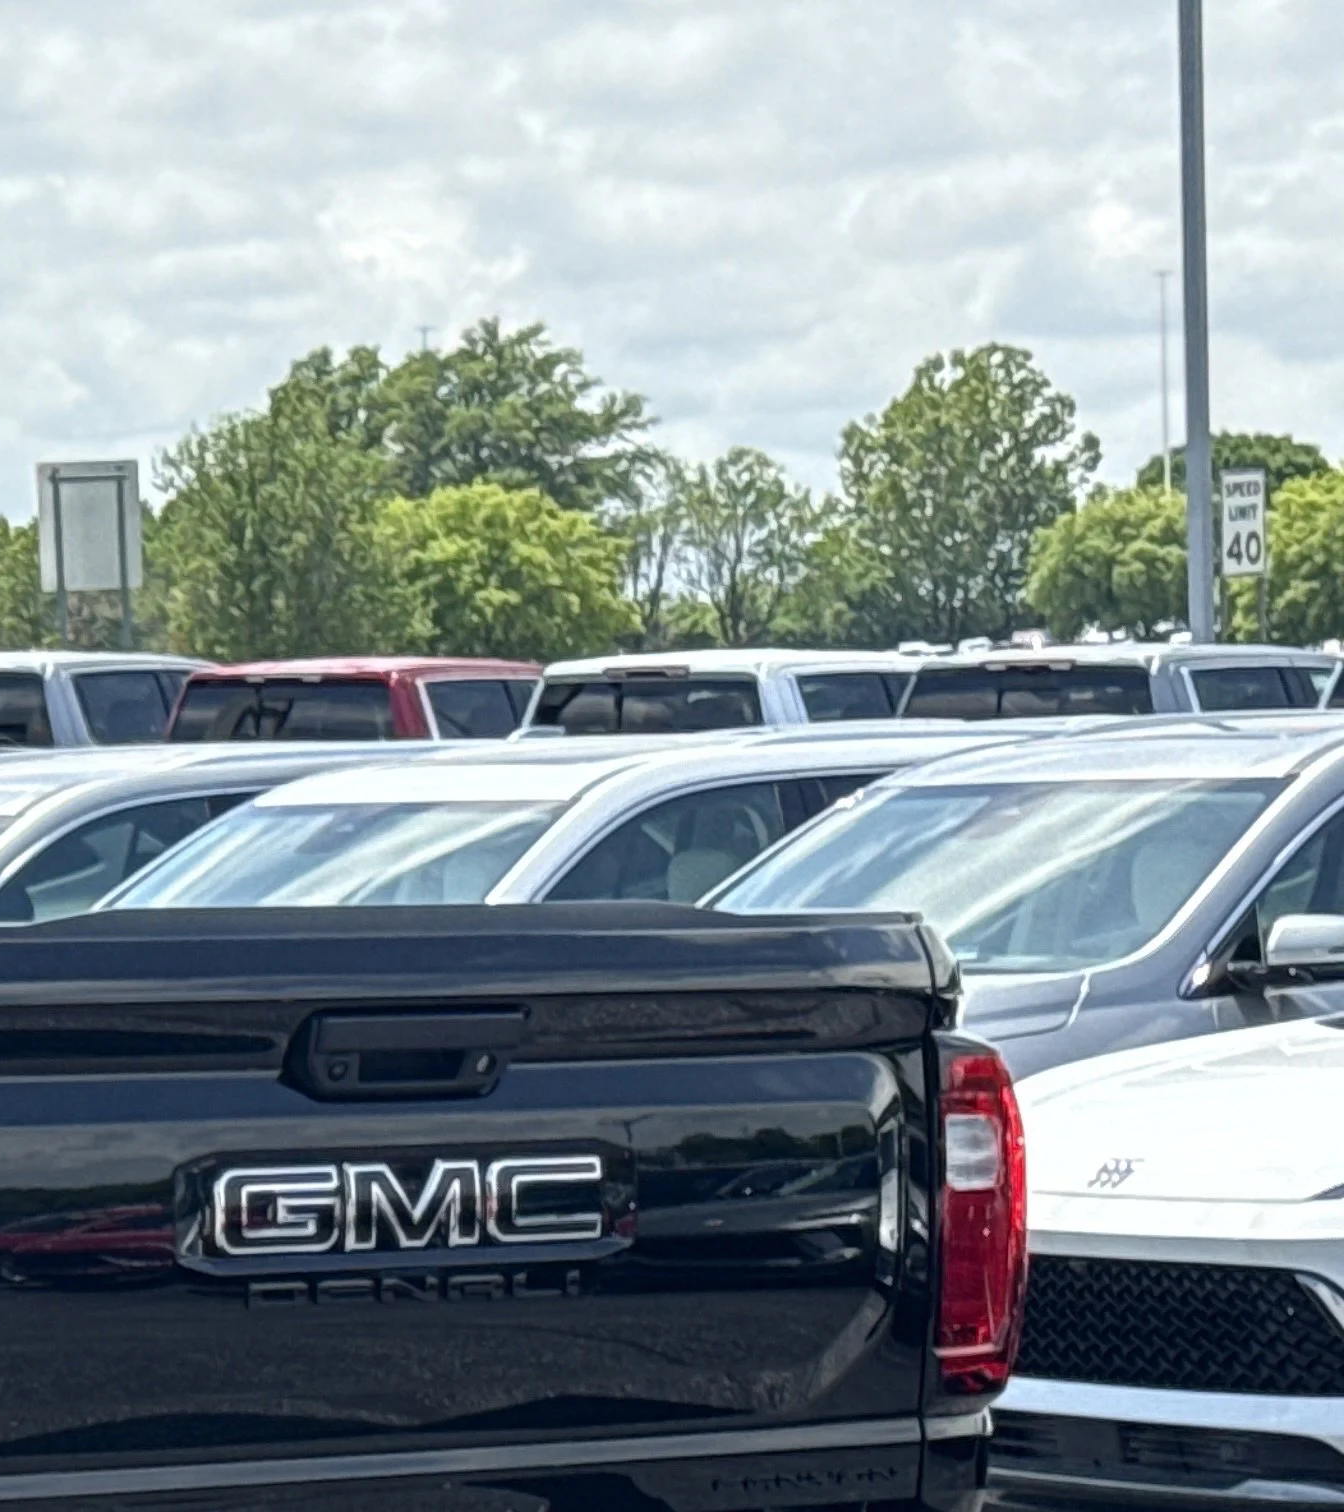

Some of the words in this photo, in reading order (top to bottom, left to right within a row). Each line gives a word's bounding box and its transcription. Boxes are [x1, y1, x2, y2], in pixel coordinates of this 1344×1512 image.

[1225, 480, 1261, 498] SPEED
[1228, 503, 1258, 522] LIMIT
[1226, 529, 1262, 566] 40
[214, 1155, 603, 1256] GMC
[247, 1268, 581, 1308] DENALI
